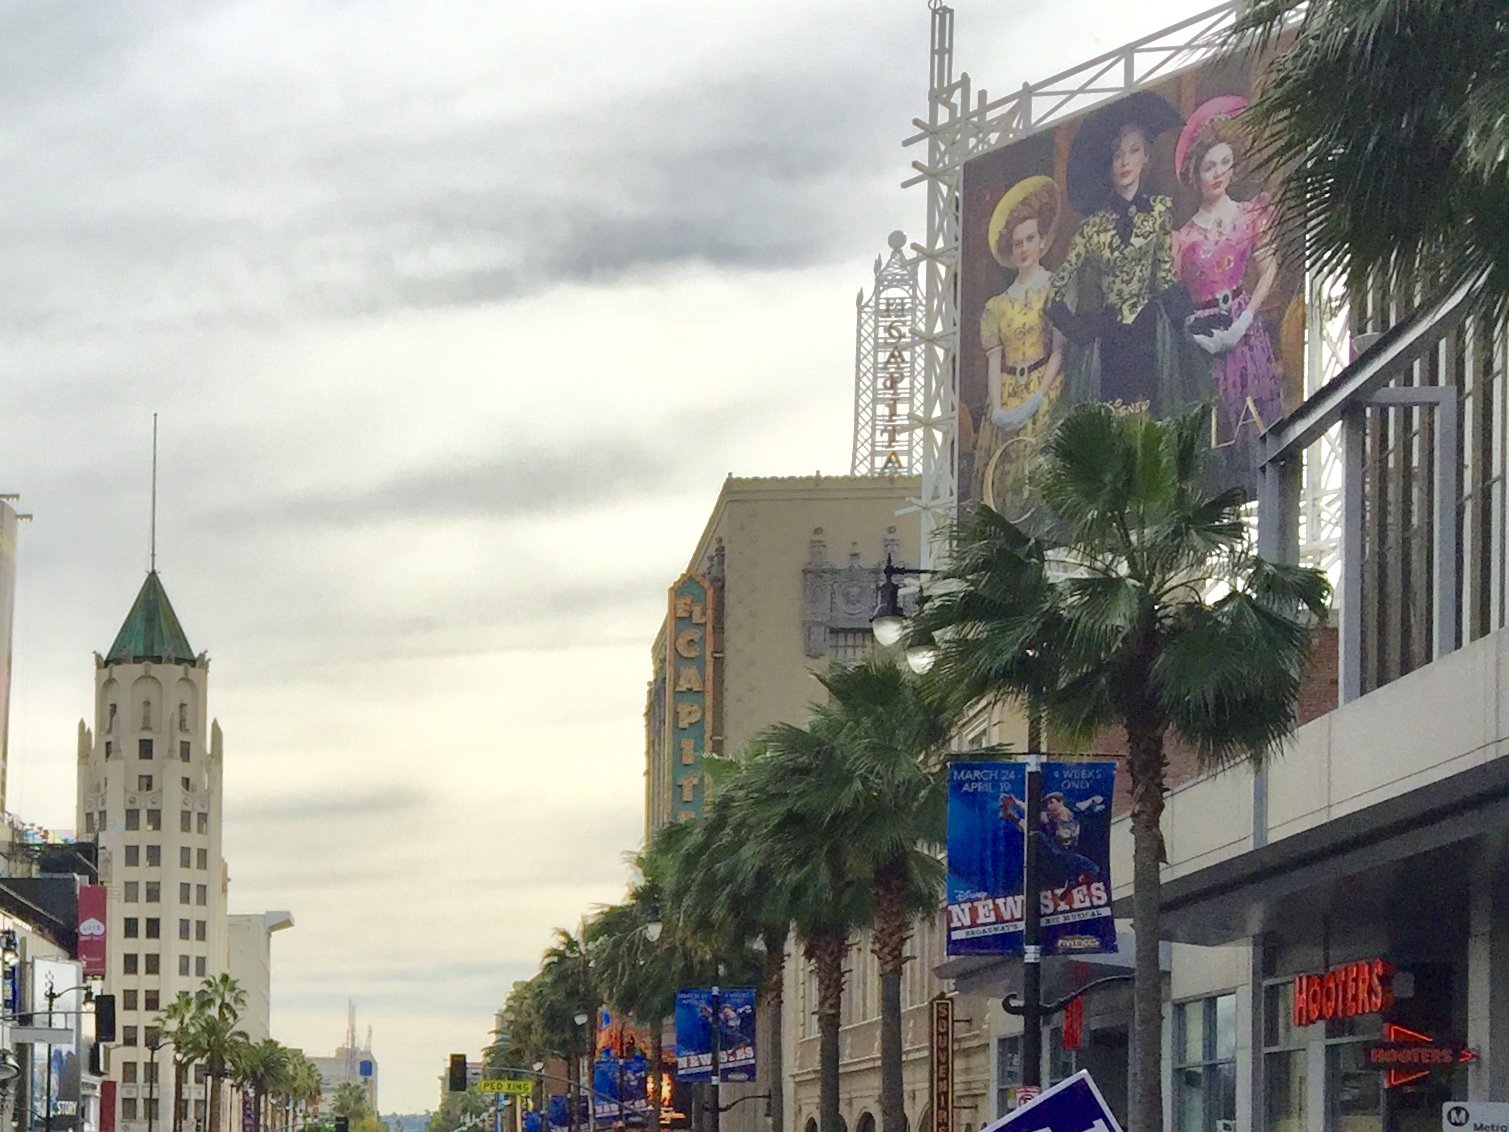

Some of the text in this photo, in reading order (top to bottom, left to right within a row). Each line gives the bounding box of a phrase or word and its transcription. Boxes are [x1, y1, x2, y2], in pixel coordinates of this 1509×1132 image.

[675, 595, 706, 624] EL
[953, 770, 998, 781] MARCH
[1063, 770, 1104, 780] WEEKS
[961, 781, 995, 793] APRIL
[1061, 780, 1092, 790] ONLY
[1294, 958, 1385, 1027] HOOTERS
[484, 1082, 530, 1091] PED XING
[1473, 1123, 1508, 1132] Metro
